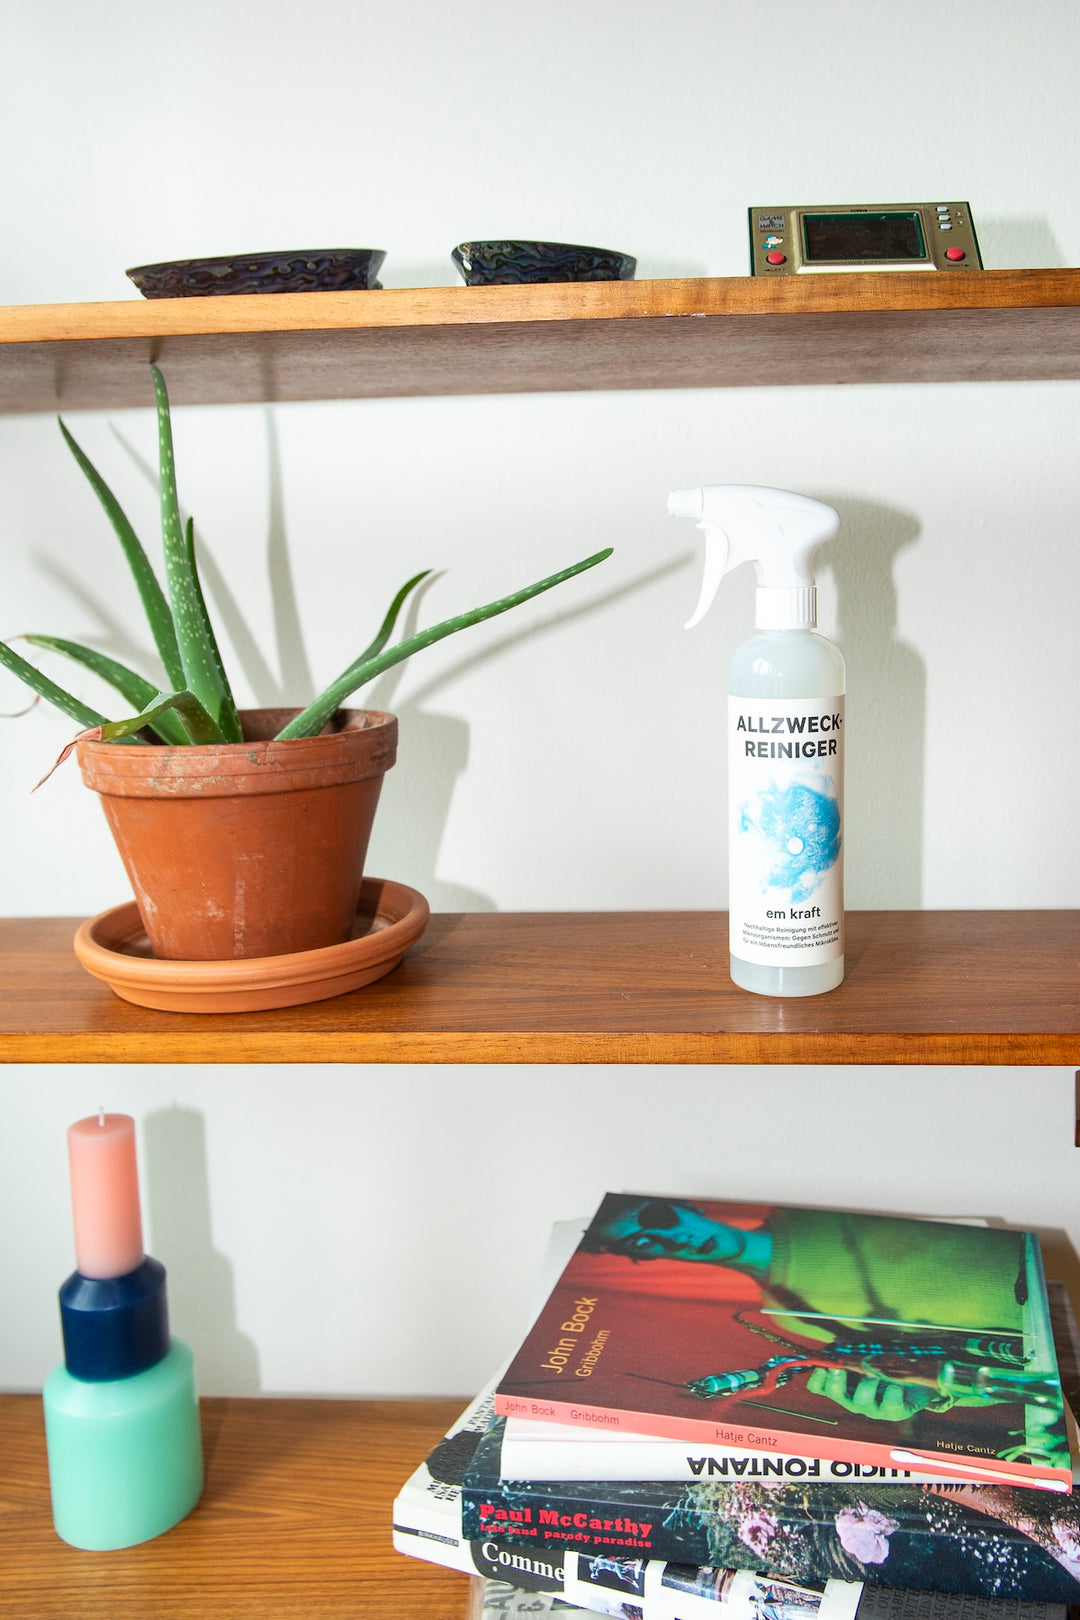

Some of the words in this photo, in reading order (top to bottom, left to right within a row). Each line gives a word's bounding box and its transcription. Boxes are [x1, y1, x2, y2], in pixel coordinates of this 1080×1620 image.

[737, 713, 842, 733] ALLZWECK-
[745, 739, 837, 758] REINIGER
[766, 910, 785, 919] em
[790, 906, 821, 919] kraft
[540, 1337, 578, 1374] John
[560, 1296, 599, 1332] Bock
[575, 1330, 611, 1377] Gribbohm
[504, 1402, 527, 1412] John
[532, 1404, 556, 1416] Bock
[570, 1409, 620, 1425] Gribbohm
[716, 1428, 743, 1443] Hatje
[747, 1433, 778, 1447] Cantz
[936, 1440, 963, 1452] Hatje
[966, 1444, 996, 1455] Cantz
[687, 1457, 820, 1477] FONTANA
[479, 1504, 532, 1523] Paul
[538, 1509, 653, 1538] McCarthy
[508, 1525, 538, 1536] land
[544, 1530, 590, 1543] parody
[593, 1535, 652, 1548] paradise
[481, 1542, 565, 1582] Comme
